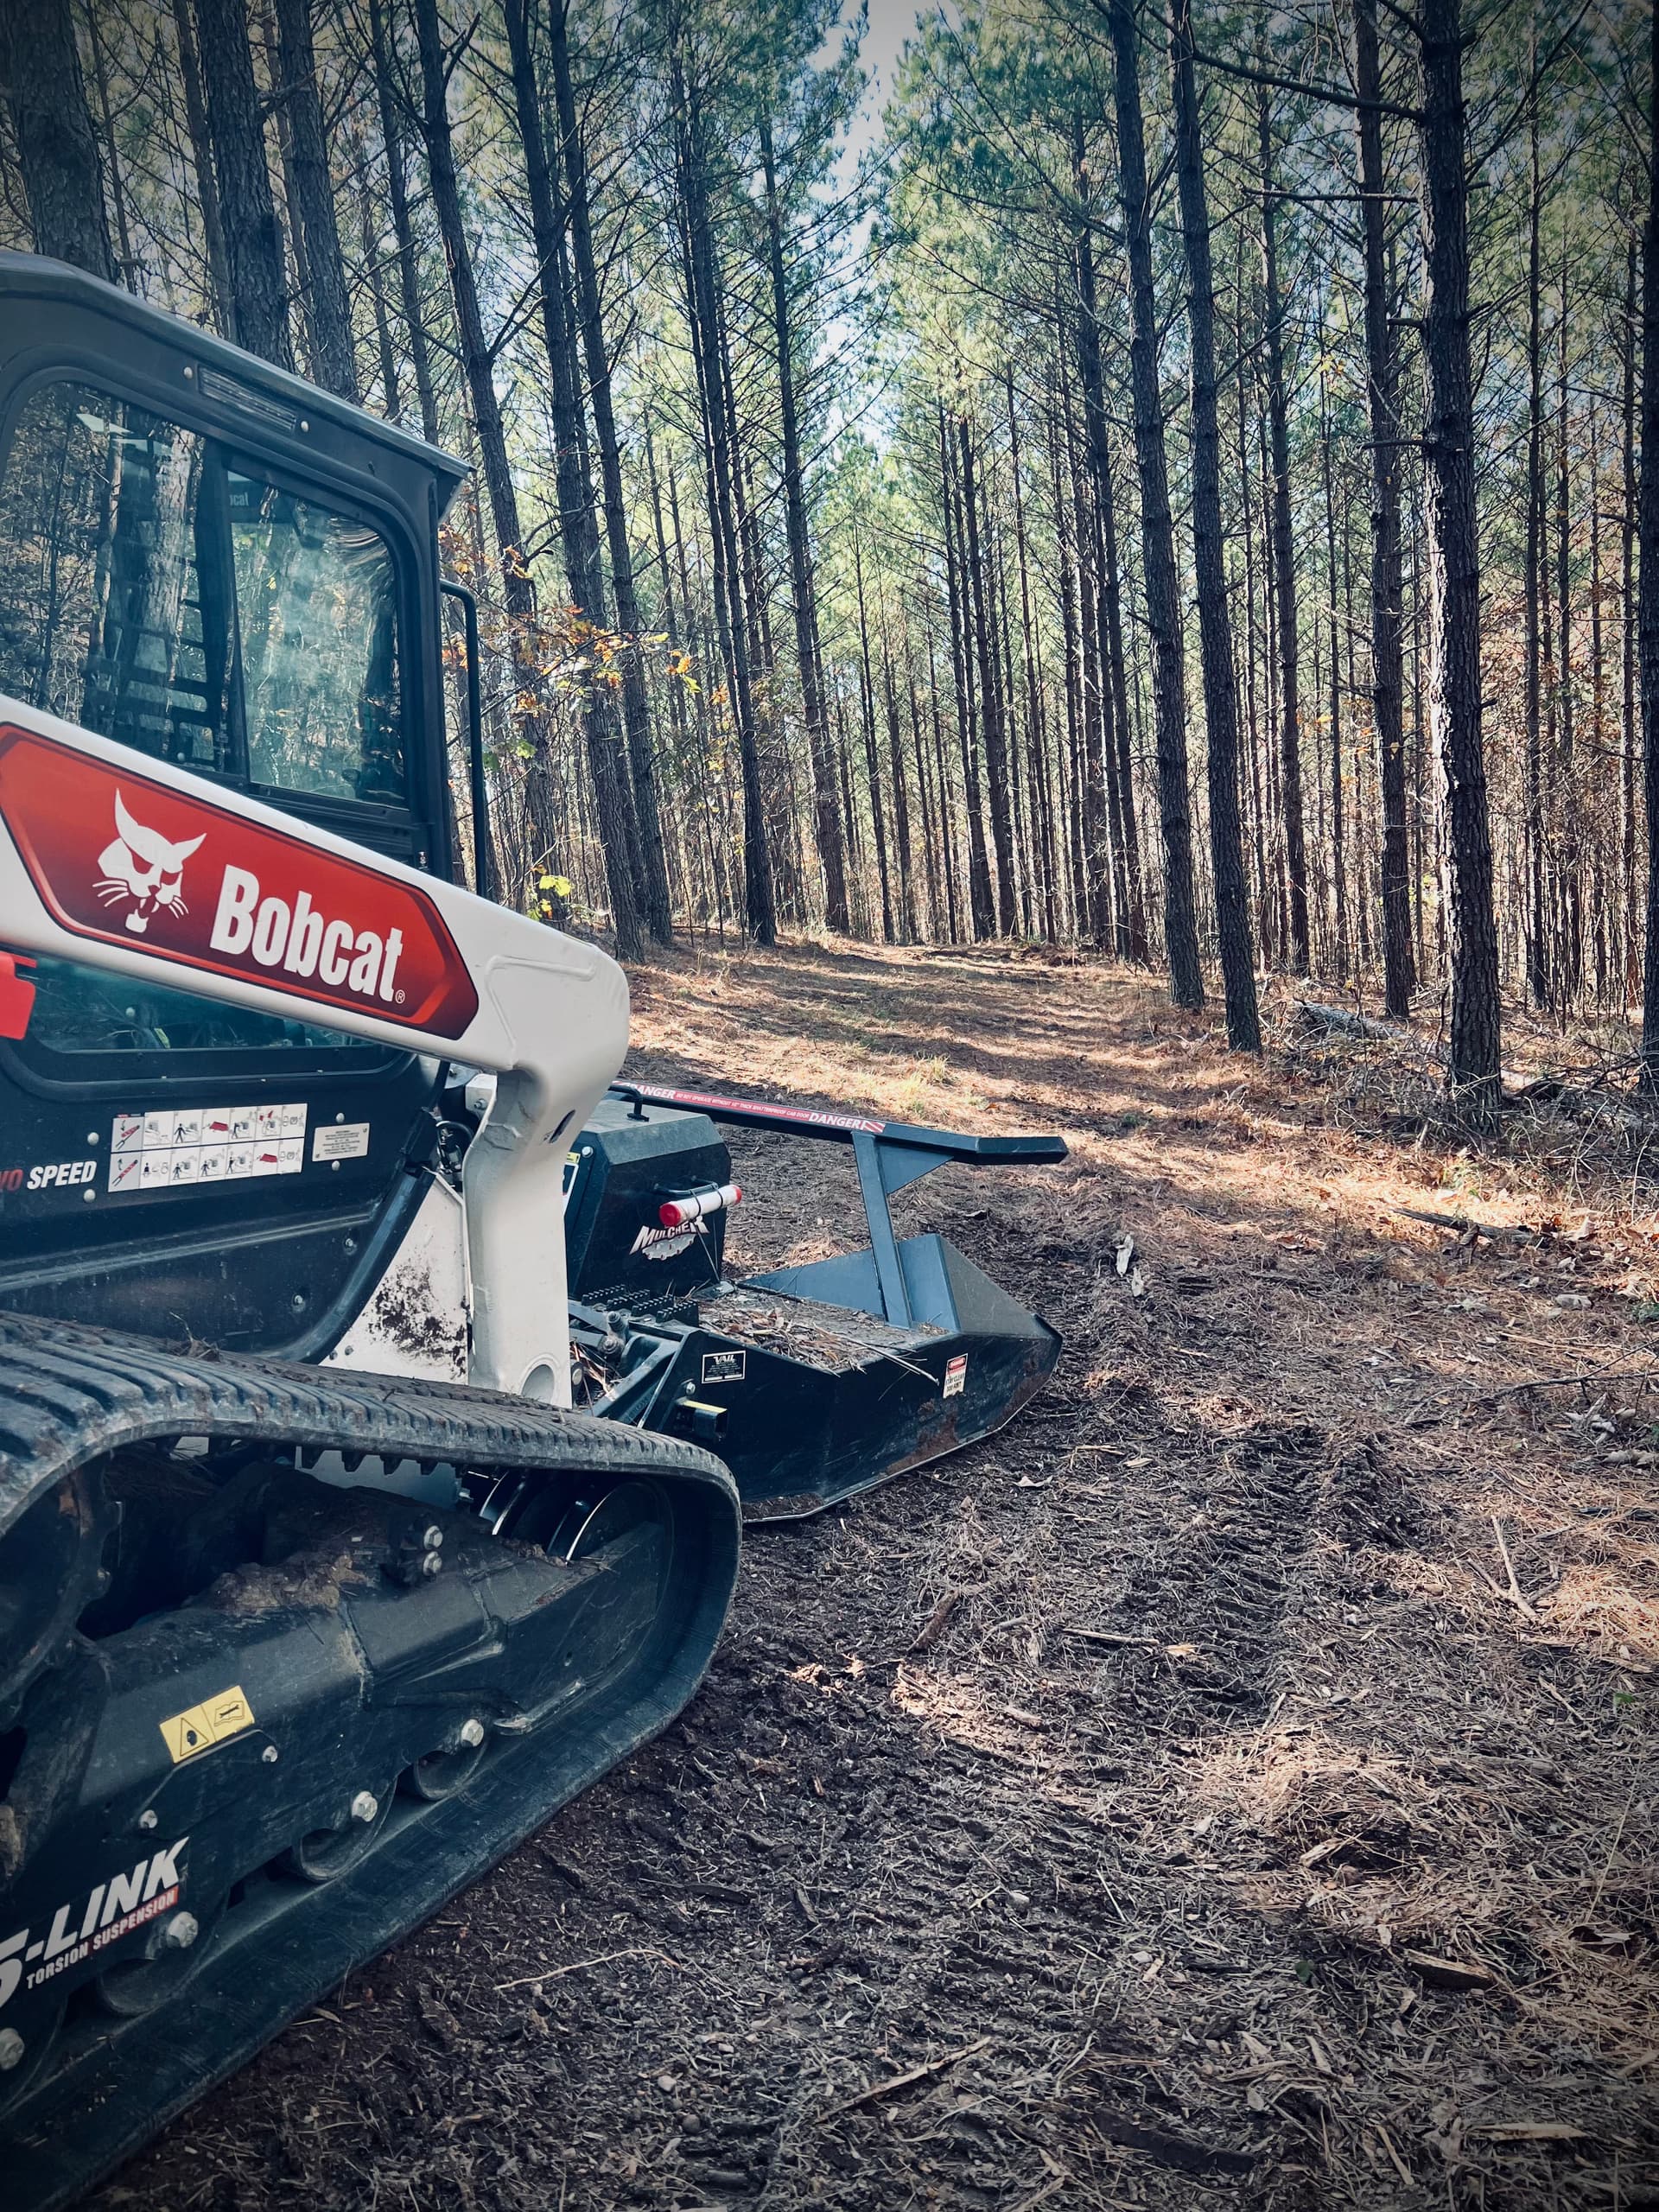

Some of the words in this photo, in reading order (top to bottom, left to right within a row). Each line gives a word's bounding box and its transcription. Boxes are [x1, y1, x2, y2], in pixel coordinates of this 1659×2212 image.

[210, 864, 404, 1002] Bobcat
[809, 1112, 862, 1130] DANGER
[27, 1161, 97, 1189] SPEED
[27, 1942, 89, 1989] TORSION
[92, 1890, 175, 1951] SUSPENSION
